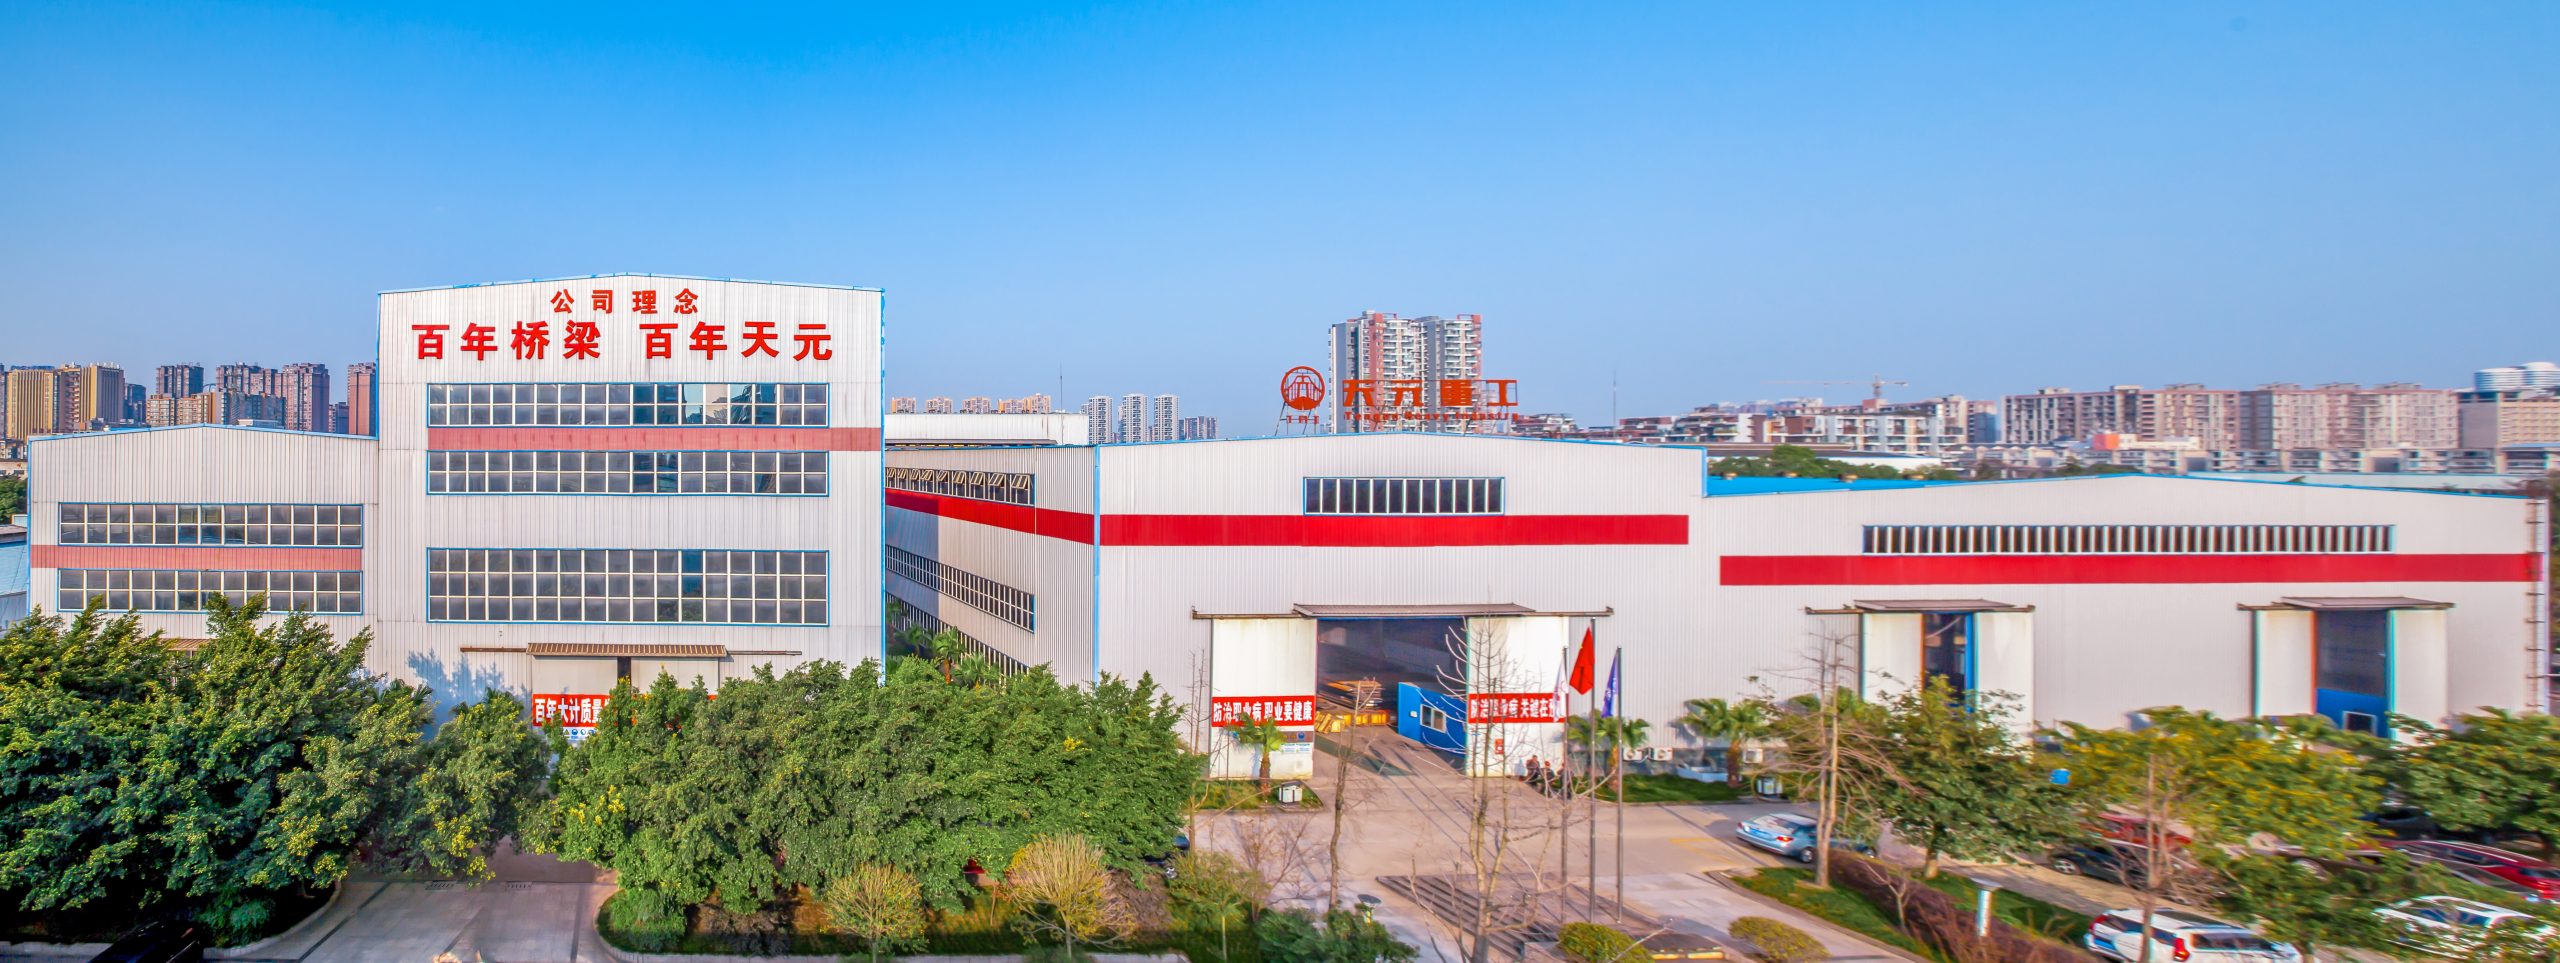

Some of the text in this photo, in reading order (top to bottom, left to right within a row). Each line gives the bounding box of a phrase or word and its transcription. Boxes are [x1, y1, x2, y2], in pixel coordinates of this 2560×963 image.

[550, 288, 699, 314] 公司理念
[411, 320, 833, 361] 百年桥梁 百年天元
[1343, 378, 1518, 407] 天元重工
[1213, 700, 1313, 722] 防治职业病 职业要健康
